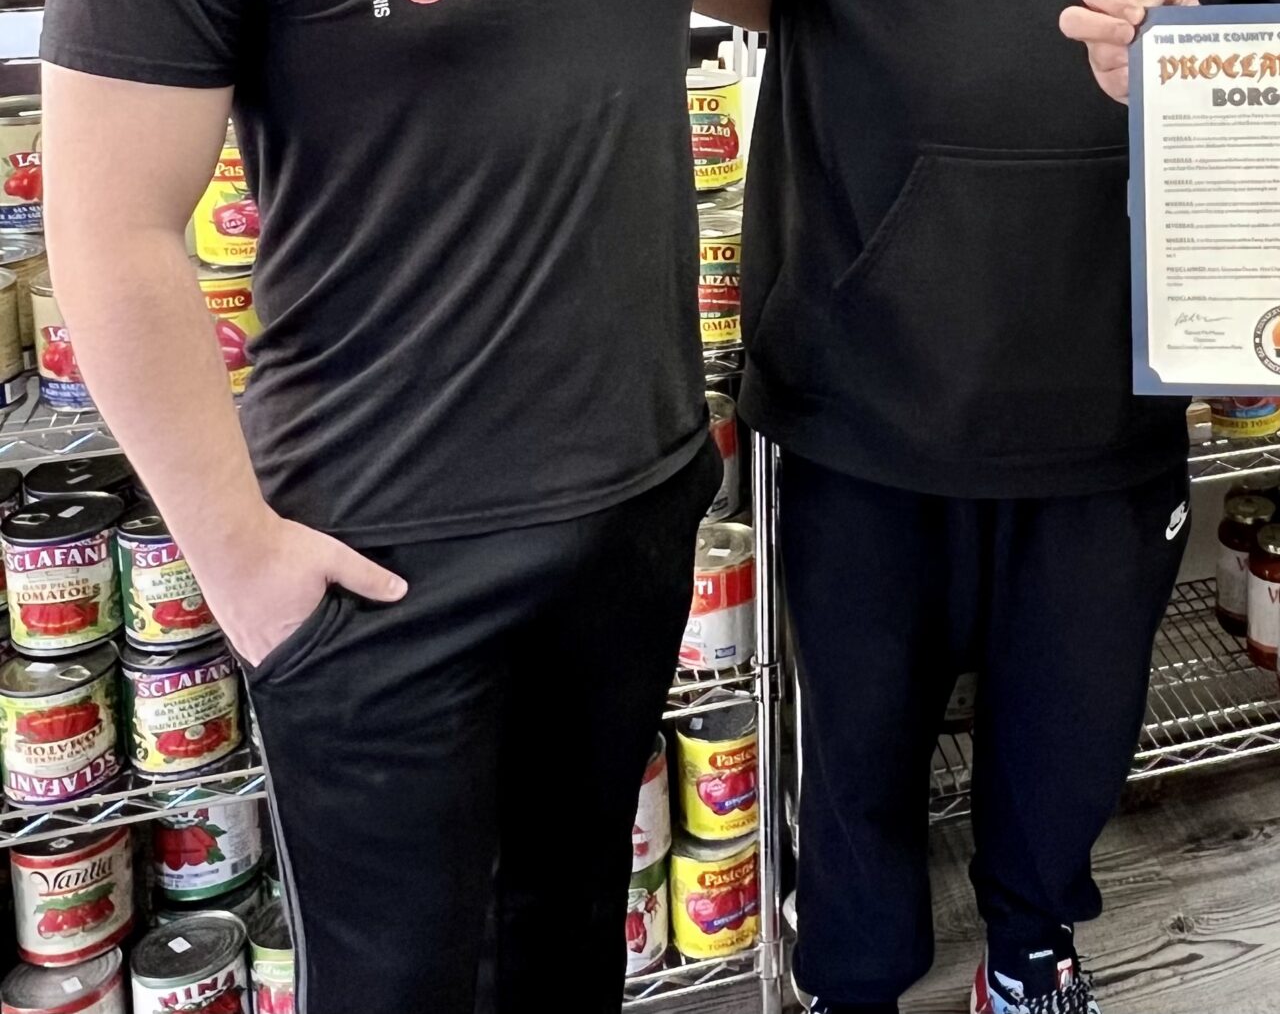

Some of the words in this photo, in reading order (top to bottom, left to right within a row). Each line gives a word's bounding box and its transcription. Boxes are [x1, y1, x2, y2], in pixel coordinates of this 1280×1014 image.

[1154, 33, 1174, 44] THE
[1178, 32, 1220, 44] BRONX
[1223, 30, 1274, 42] COUNTY
[6, 543, 107, 571] SCLAFANI
[17, 583, 101, 602] TOMATOES
[10, 749, 116, 796] SCLAFANI
[158, 969, 236, 1008] NINA
